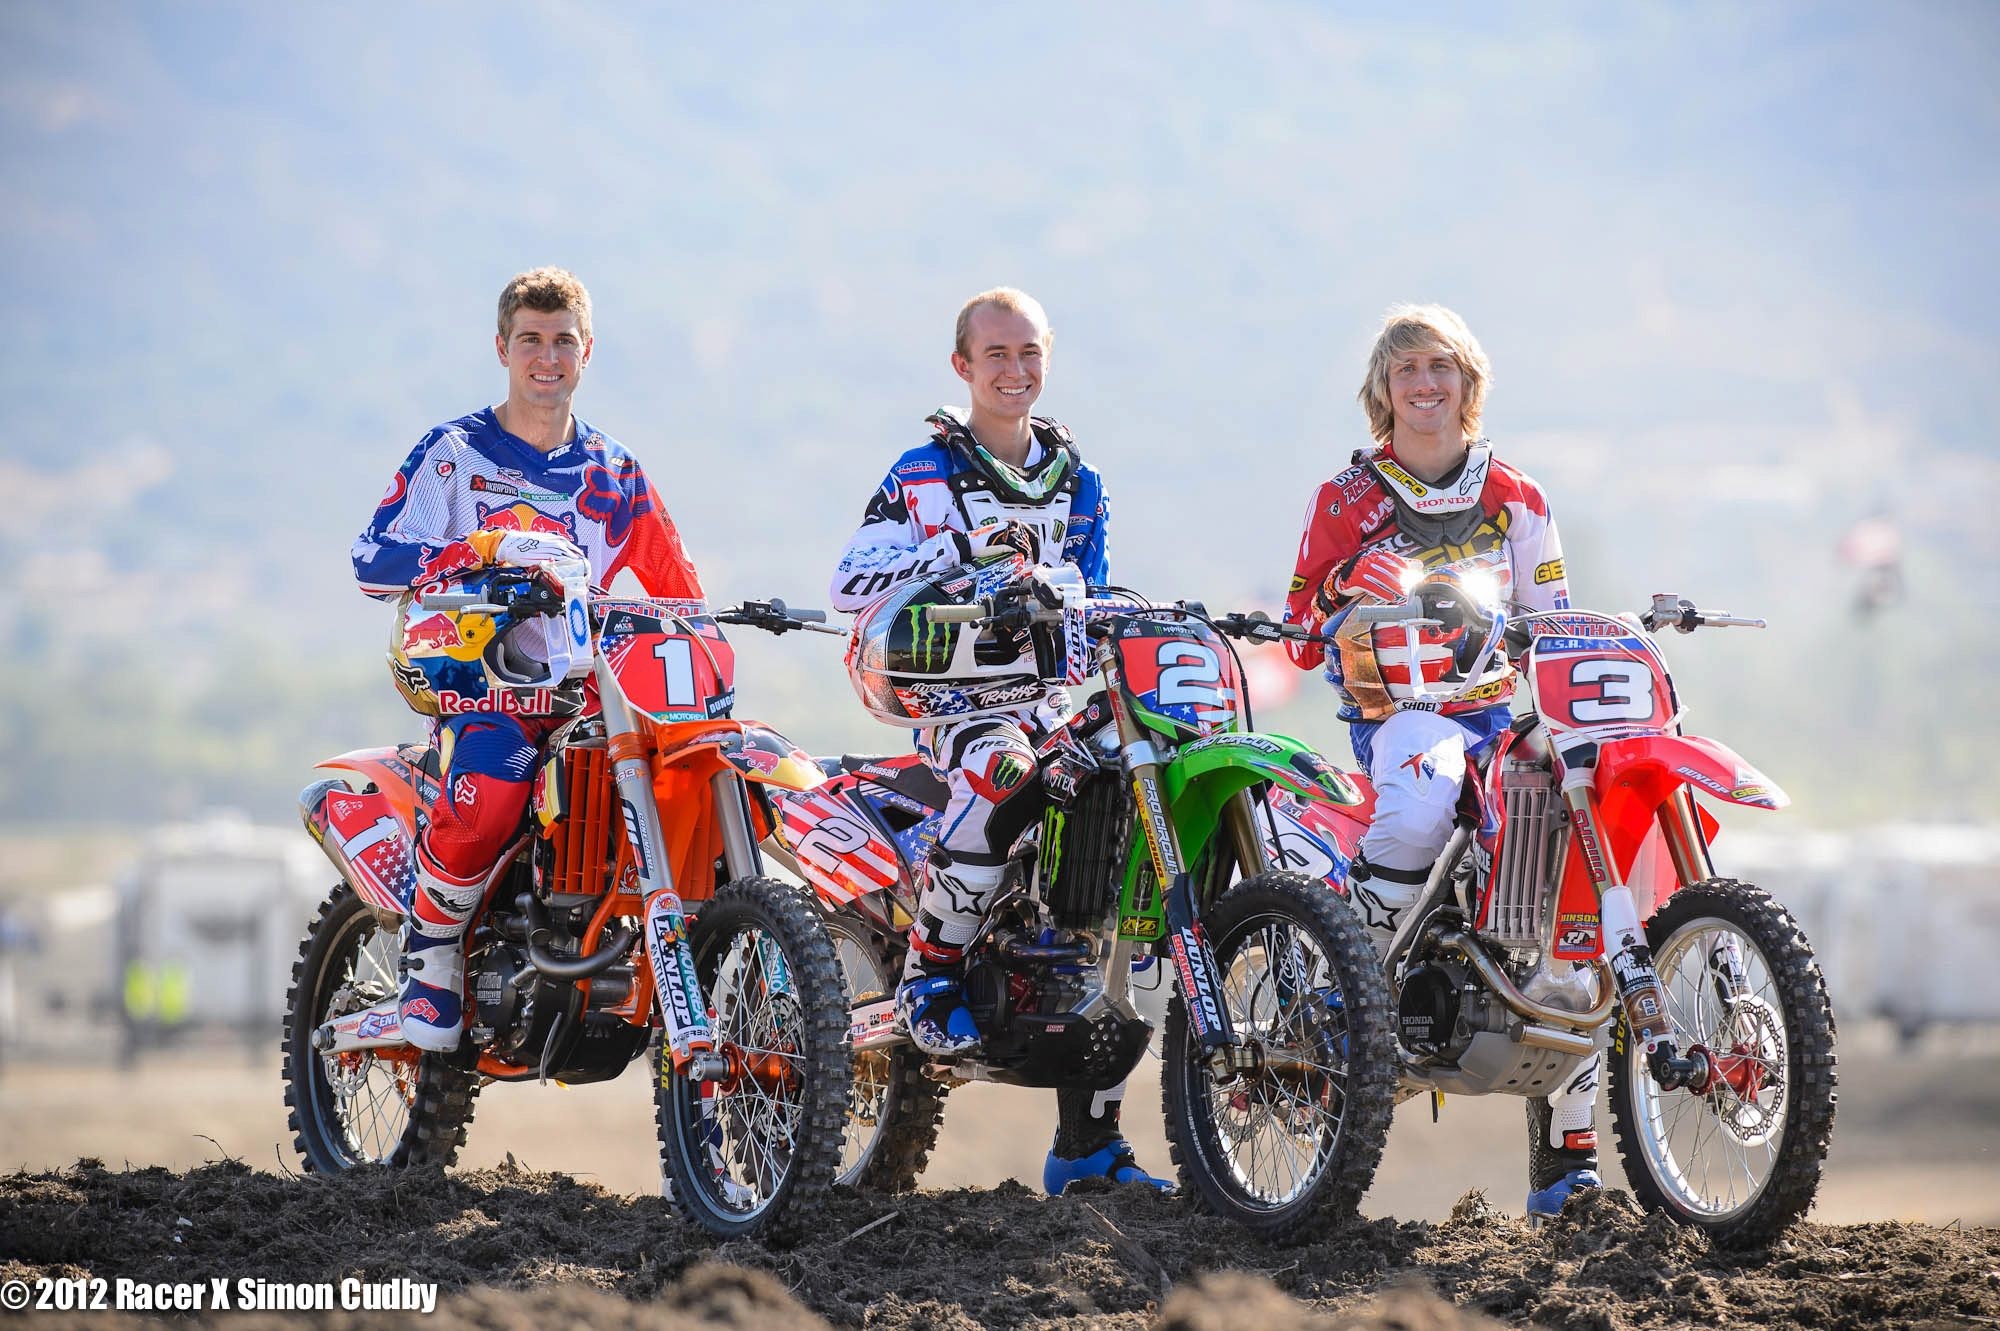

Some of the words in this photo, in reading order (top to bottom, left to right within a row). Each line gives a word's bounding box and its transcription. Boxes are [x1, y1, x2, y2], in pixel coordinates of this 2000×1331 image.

[547, 443, 573, 461] FOX
[1378, 462, 1427, 497] GEICO
[1416, 497, 1475, 510] HONDA
[943, 579, 972, 593] VANS
[1069, 608, 1082, 673] SCOTT
[652, 637, 697, 707] 1
[1157, 640, 1225, 708] 2
[439, 689, 496, 714] Red
[500, 688, 552, 714] Bull
[978, 683, 1039, 707] TRAXXAS
[1402, 701, 1437, 713] SHOEI
[1569, 658, 1654, 725] 3
[1217, 734, 1284, 753] CIRCUIT
[859, 763, 901, 779] Kawasaki
[1677, 766, 1730, 794] DUNLOP
[796, 816, 870, 875] 2
[1143, 817, 1165, 879] SHOWA
[1153, 815, 1179, 876] CIRCUIT
[679, 940, 707, 1021] MOTOREX
[1172, 933, 1198, 999] BRAKING
[1181, 926, 1222, 1031] DUNLOP
[652, 955, 671, 1014] ATHENA
[401, 997, 441, 1024] USA
[1402, 1016, 1434, 1025] HONDA
